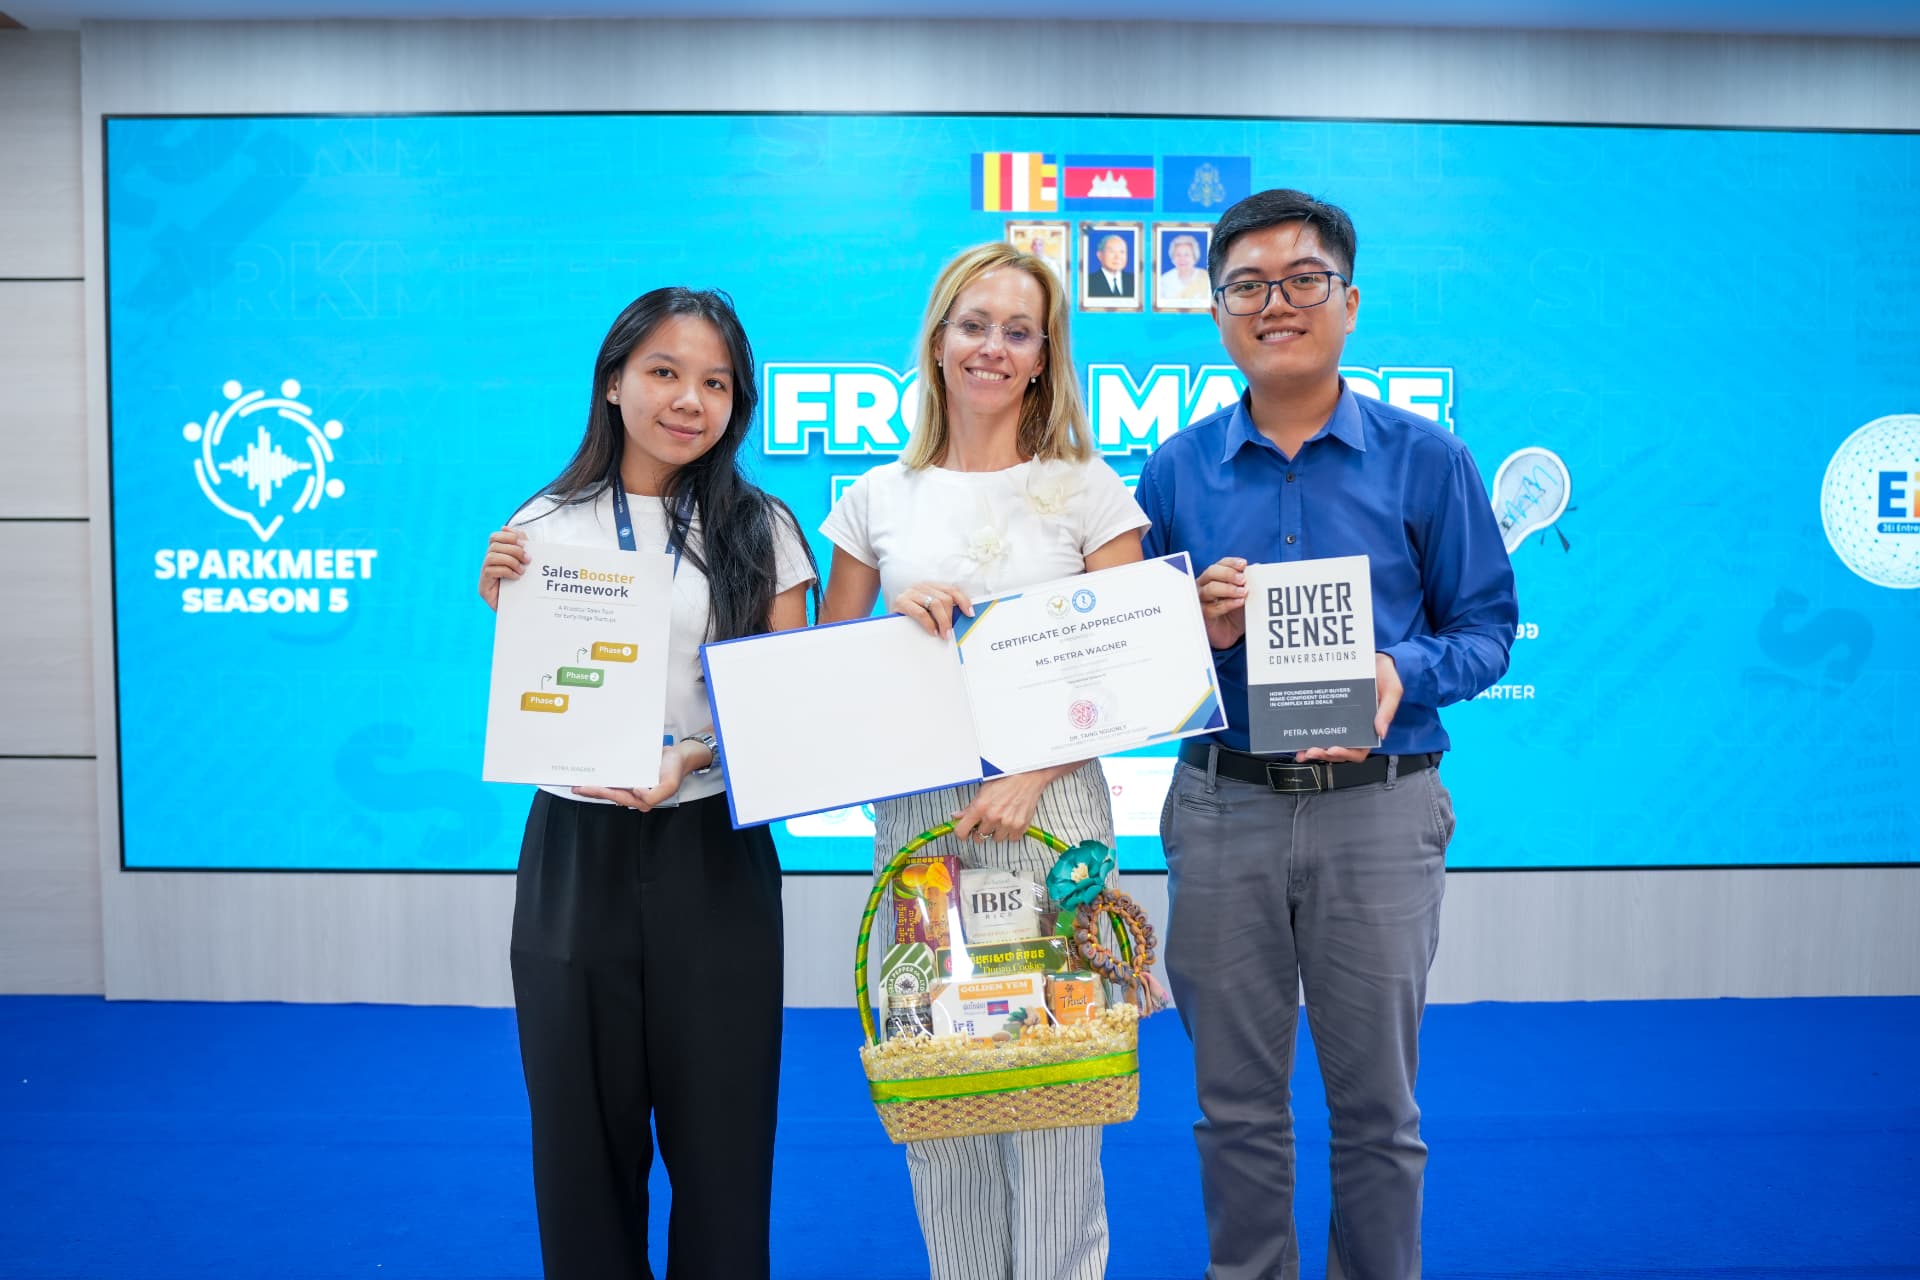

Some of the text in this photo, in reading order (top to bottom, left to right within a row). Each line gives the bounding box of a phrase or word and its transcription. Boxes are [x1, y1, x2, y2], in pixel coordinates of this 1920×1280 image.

[154, 549, 379, 580] SPARKMEET
[541, 564, 636, 585] SalesBooster
[546, 579, 629, 598] Framework
[182, 587, 350, 614] SEASON 5
[1267, 582, 1352, 617] BUYER
[990, 628, 1060, 651] CERTIFICATE
[1062, 624, 1077, 636] OF
[1080, 605, 1162, 632] APPRECIATION
[1268, 615, 1355, 650] SENSE
[599, 646, 622, 655] Phase
[1035, 640, 1128, 667] MS. PETRA WAGNER
[1269, 650, 1357, 665] CONVERSATIONS
[566, 671, 589, 680] Phase
[530, 695, 554, 705] Phase
[1283, 726, 1347, 737] PETRA WAGNER
[971, 888, 1023, 914] IBIS
[960, 984, 1003, 993] GOLDEN
